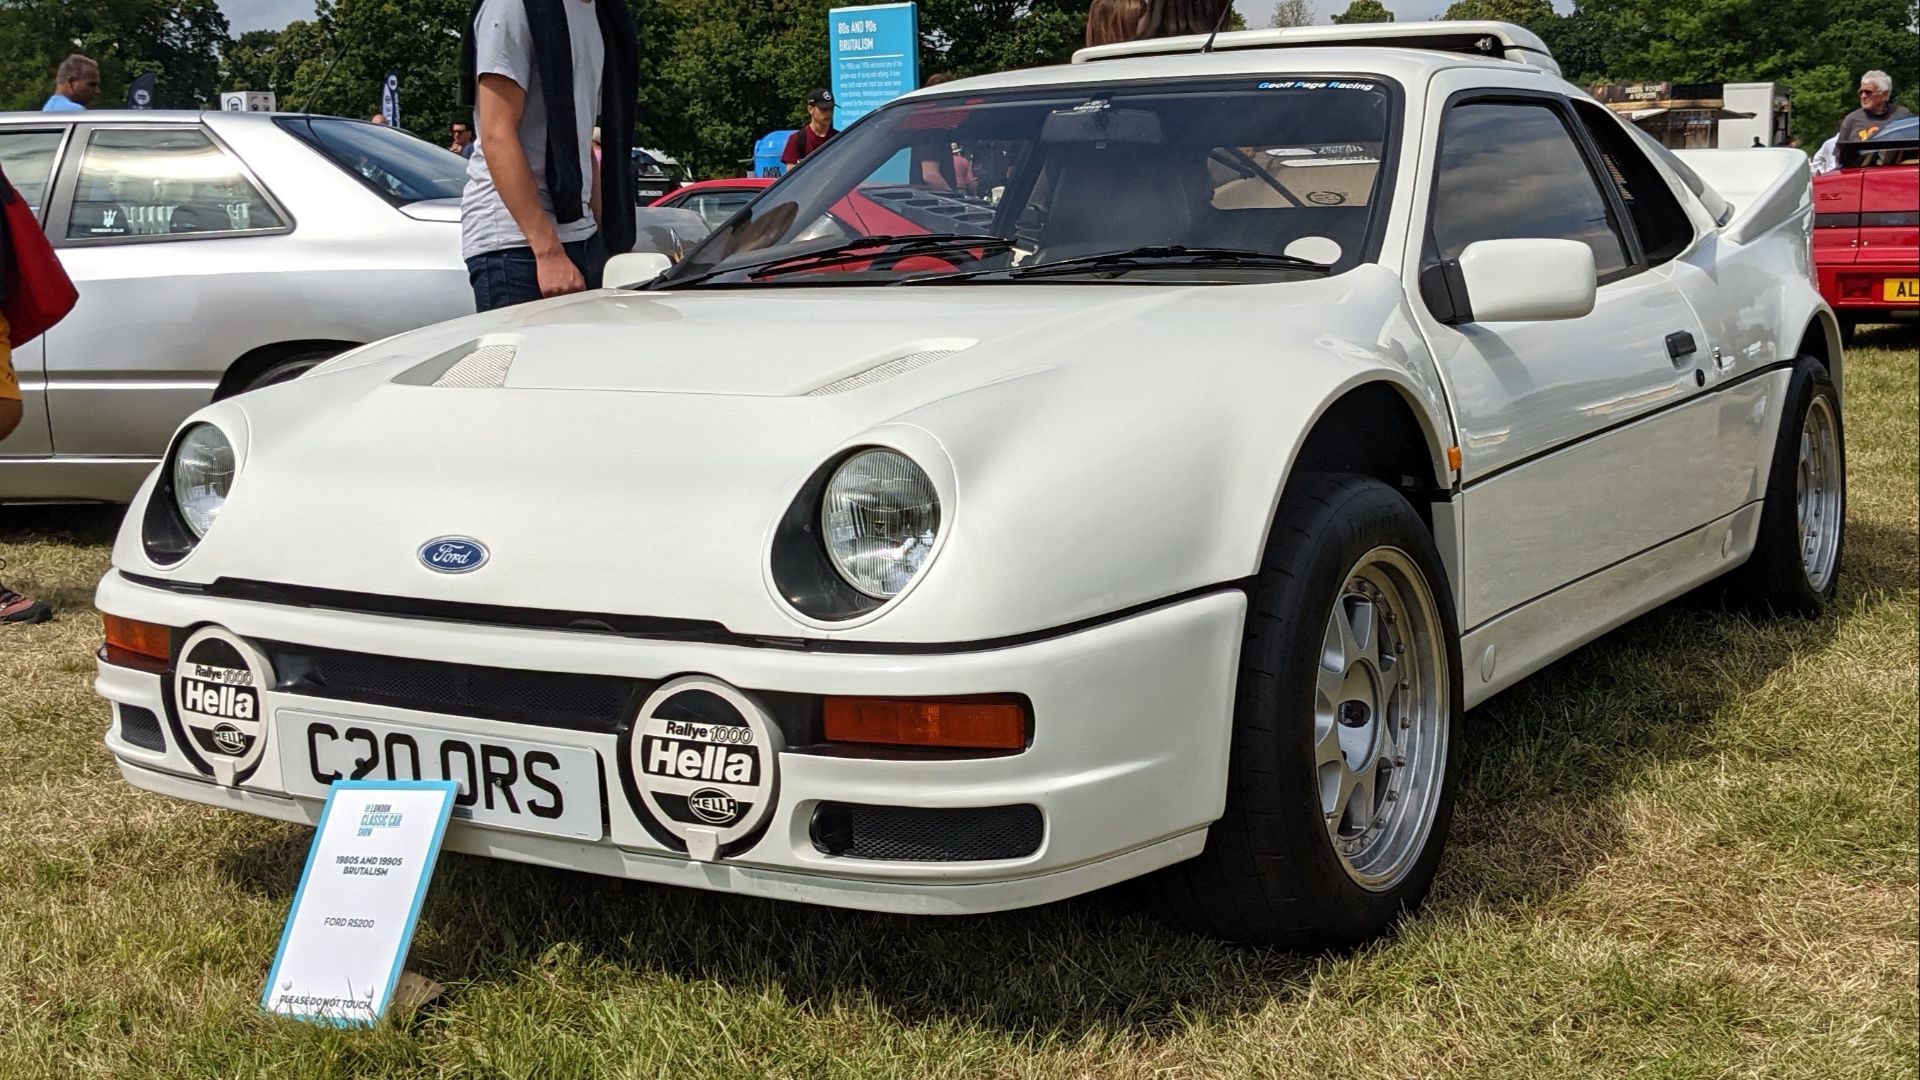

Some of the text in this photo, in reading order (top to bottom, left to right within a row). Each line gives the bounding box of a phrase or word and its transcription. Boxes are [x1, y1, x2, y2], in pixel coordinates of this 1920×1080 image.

[838, 20, 877, 34] 80s AND 90s
[839, 38, 874, 51] BRUTALISM
[1258, 81, 1374, 91] Geoff Page Racing
[433, 543, 473, 564] Ford
[195, 665, 253, 685] Rallye 1000
[186, 680, 254, 719] Hella
[214, 730, 246, 745] HELLA
[666, 721, 753, 744] Rallye 1000
[649, 739, 753, 783] Hella
[440, 739, 564, 819] ORS
[370, 804, 392, 812] LONDON
[692, 798, 737, 814] HELLA
[361, 815, 403, 827] CLASSIC CAR
[357, 828, 373, 836] SHOW
[336, 856, 403, 866] 1980S AND 1990S
[343, 866, 389, 876] BRUTALISM
[324, 917, 375, 928] FORD RS200
[280, 995, 371, 1009] PLEASE DO NOT TOUCH
